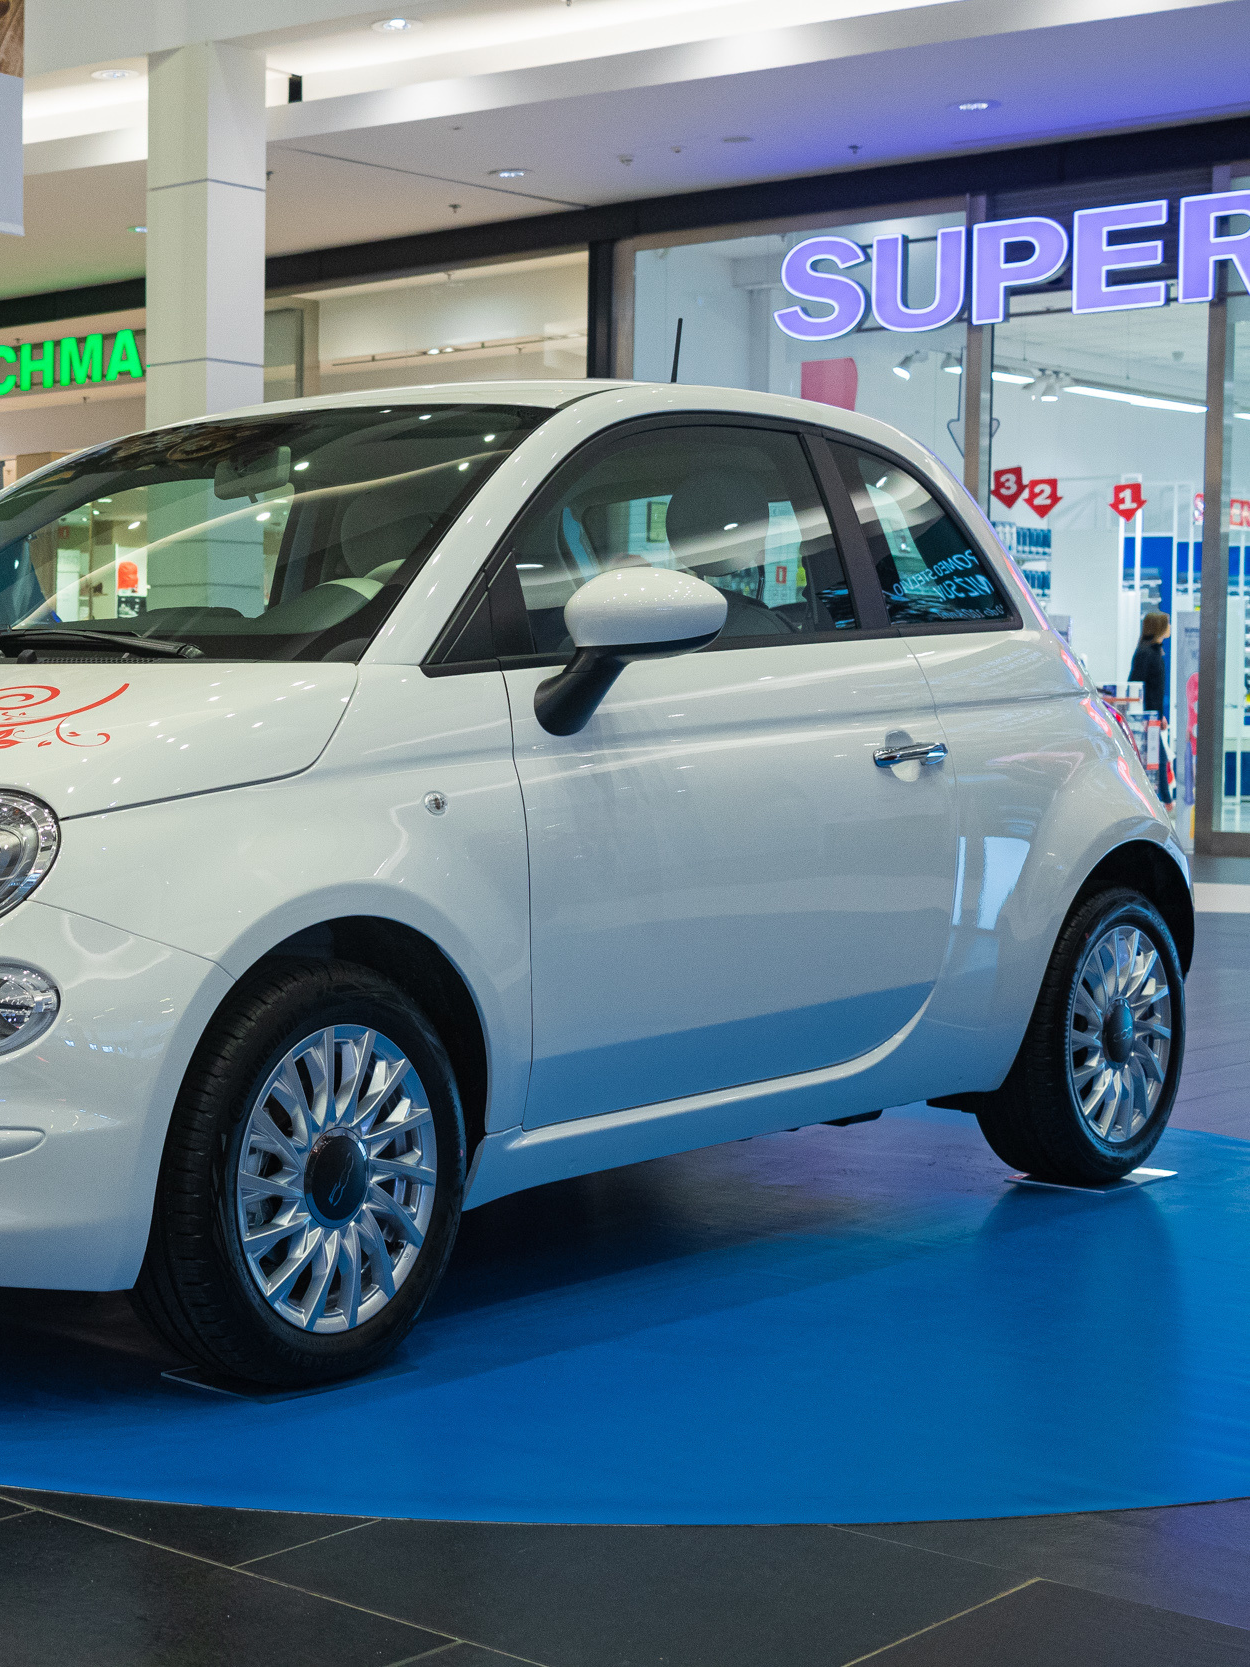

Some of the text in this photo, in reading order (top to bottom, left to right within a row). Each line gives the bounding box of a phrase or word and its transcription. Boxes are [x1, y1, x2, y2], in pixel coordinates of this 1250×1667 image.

[773, 190, 1250, 341] SUPER
[1000, 474, 1017, 496] 3
[1033, 484, 1052, 506] 2
[1118, 489, 1137, 510] 1
